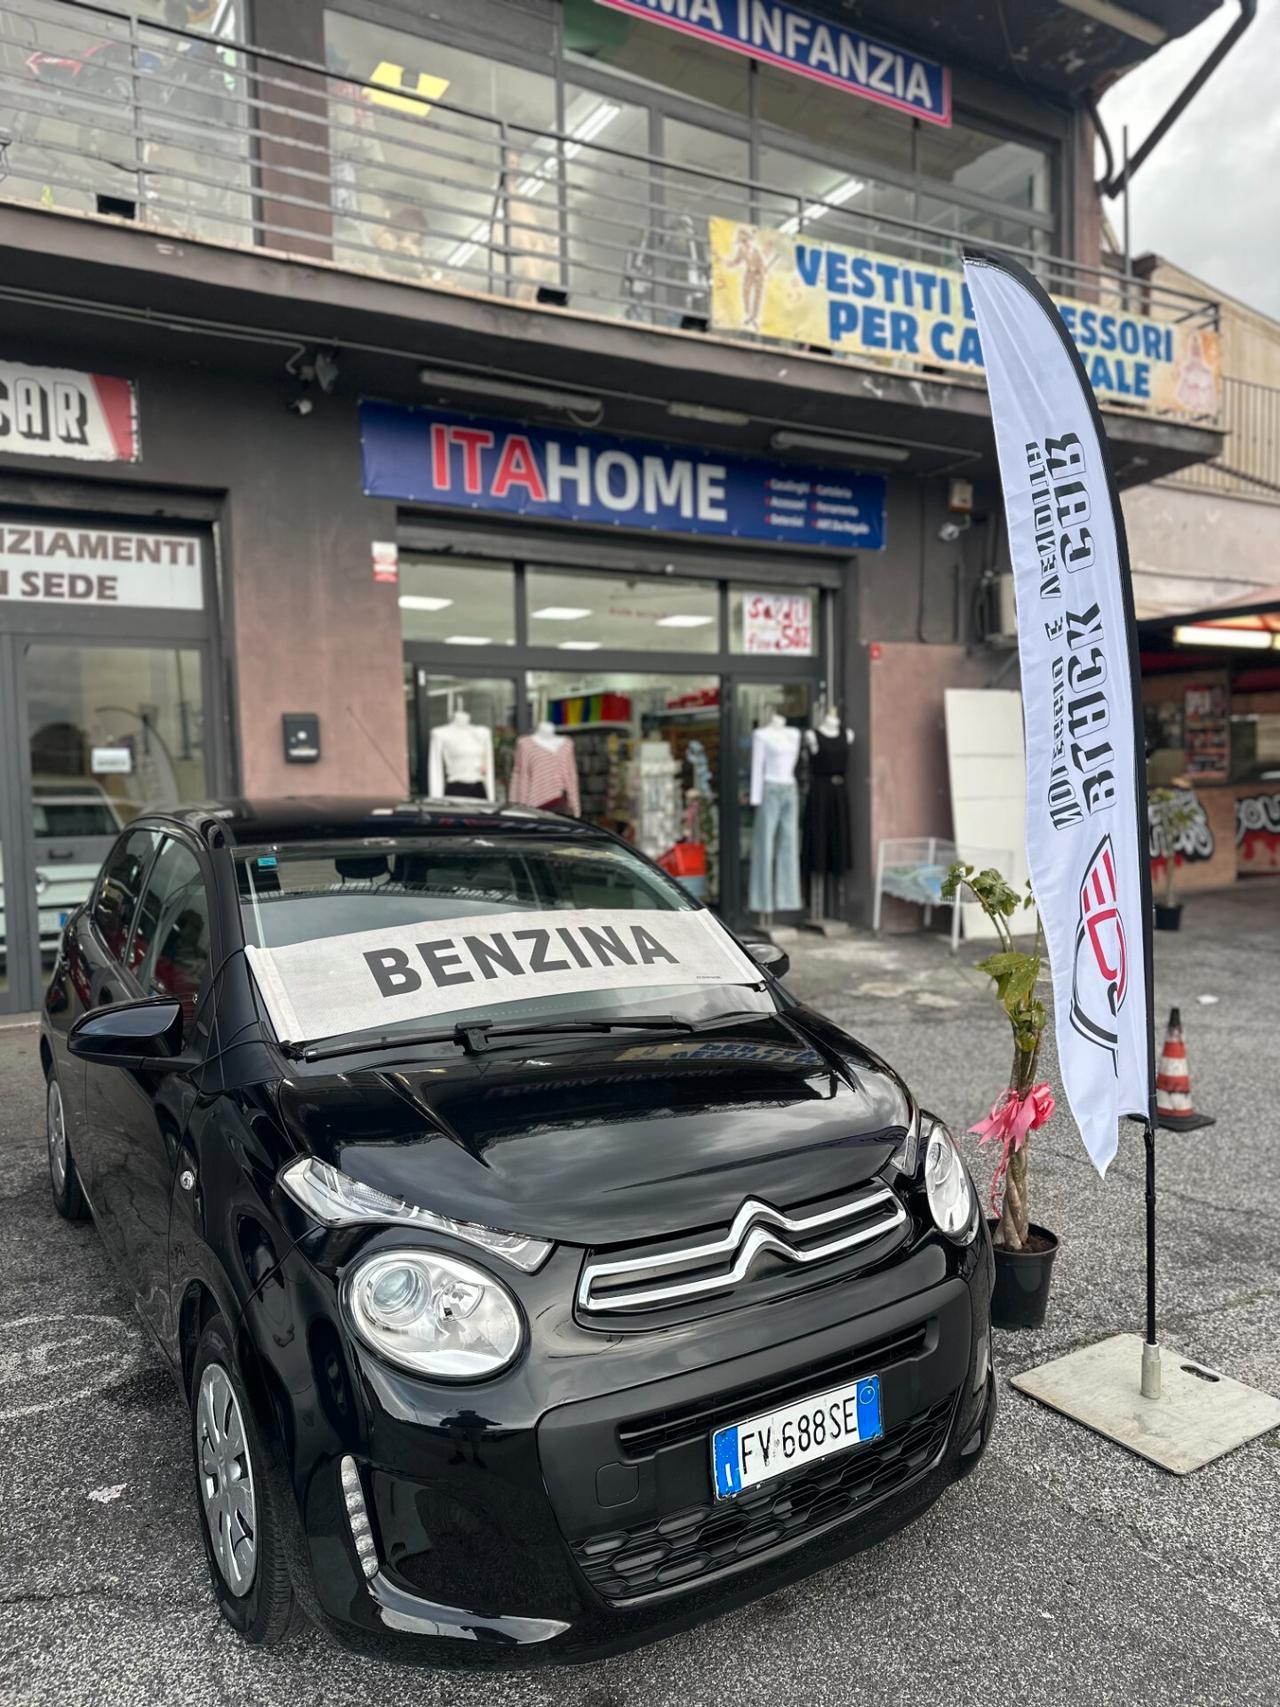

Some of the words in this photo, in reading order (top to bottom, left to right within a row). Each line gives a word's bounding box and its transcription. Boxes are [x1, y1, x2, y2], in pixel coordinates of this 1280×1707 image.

[737, 0, 934, 109] INFANZIA
[795, 244, 952, 316] VESTITI
[829, 300, 919, 354] PER
[430, 422, 728, 522] ITAHOME
[20, 570, 118, 601] SEDE
[362, 925, 680, 998] BENZINA
[741, 1426, 772, 1475] FV
[781, 1396, 857, 1459] 688SE
